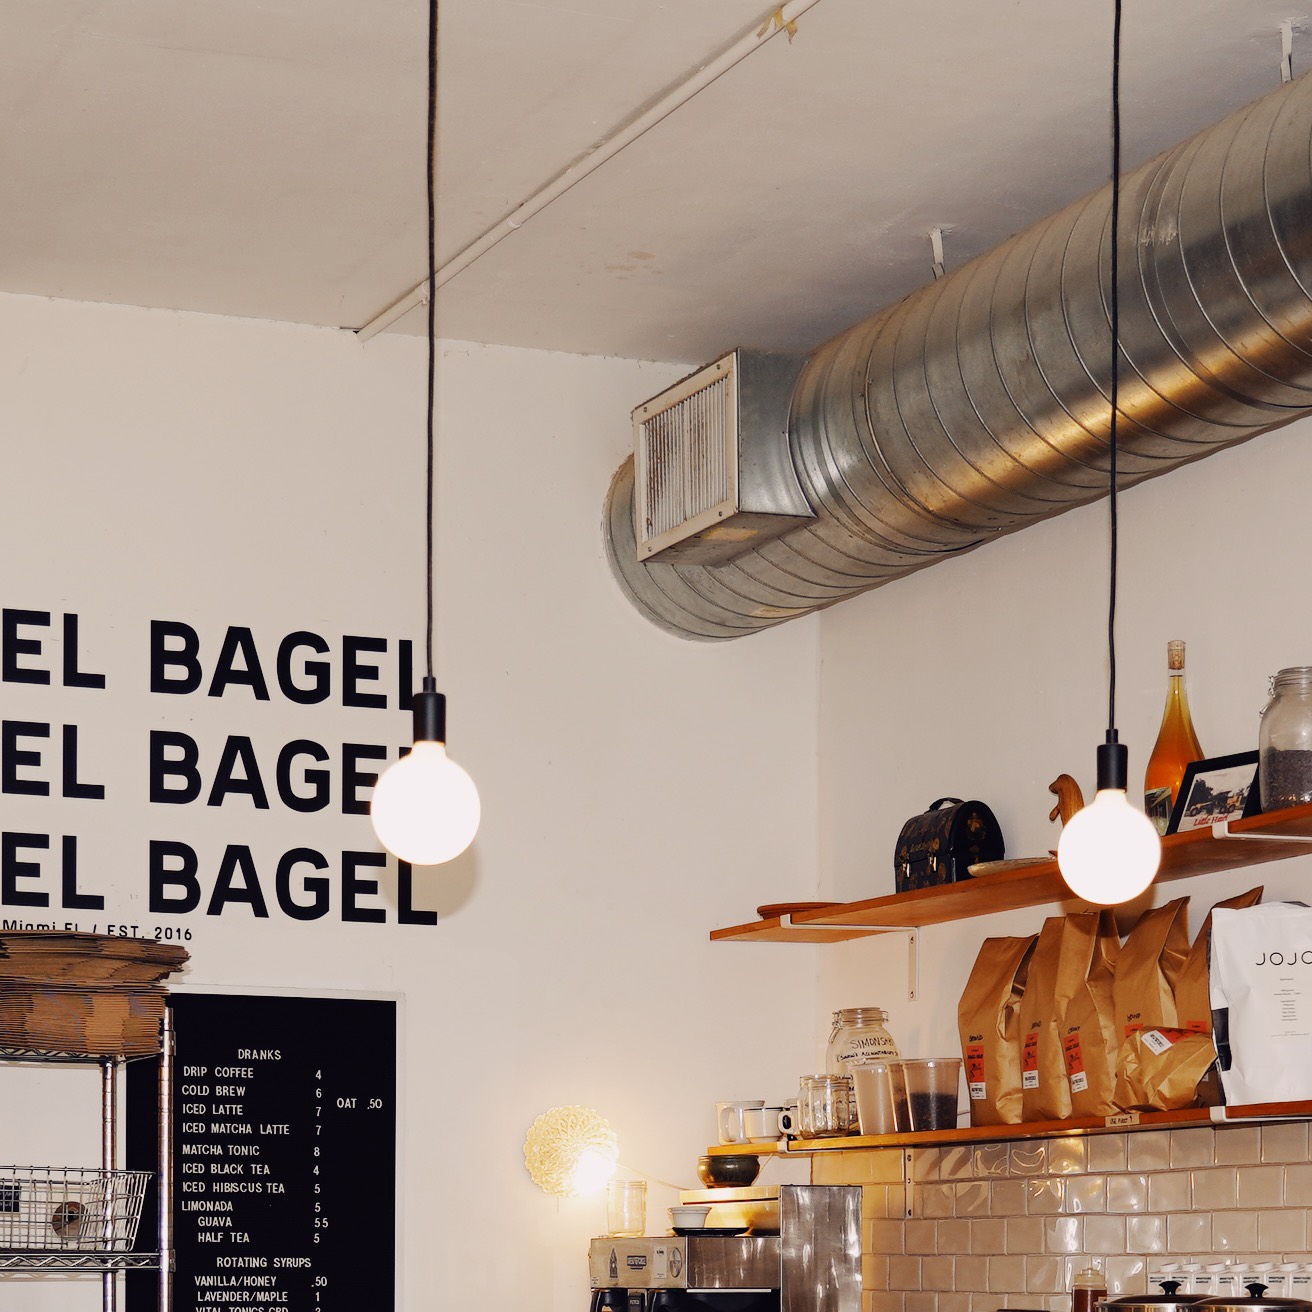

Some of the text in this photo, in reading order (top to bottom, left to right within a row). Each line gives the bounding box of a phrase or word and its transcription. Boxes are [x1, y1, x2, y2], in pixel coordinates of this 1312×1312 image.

[2, 608, 413, 711] EL BAGEL
[2, 720, 413, 815] EL BAGE
[1, 832, 438, 926] EL BAGEL
[107, 925, 192, 940] EST. 2016
[237, 1048, 282, 1061] DRANKS
[183, 1065, 254, 1079] DRIP COFFEE
[181, 1084, 246, 1097] COLD BREW
[336, 1097, 358, 1109] OAT
[182, 1103, 244, 1116] ICED LATTE
[210, 1122, 253, 1134] MATCHA
[227, 1144, 260, 1156] TONIC
[210, 1163, 271, 1175] BLACK TEA
[212, 1182, 263, 1193] HIBISCUS
[181, 1200, 234, 1212] LIMONADA
[197, 1215, 233, 1228] GUAVA
[197, 1231, 224, 1243] HALF
[216, 1256, 312, 1268] ROTATING SYRUPS
[194, 1275, 277, 1287] VANILLA/HONEY
[197, 1290, 289, 1302] LAVENDER/MAPLE
